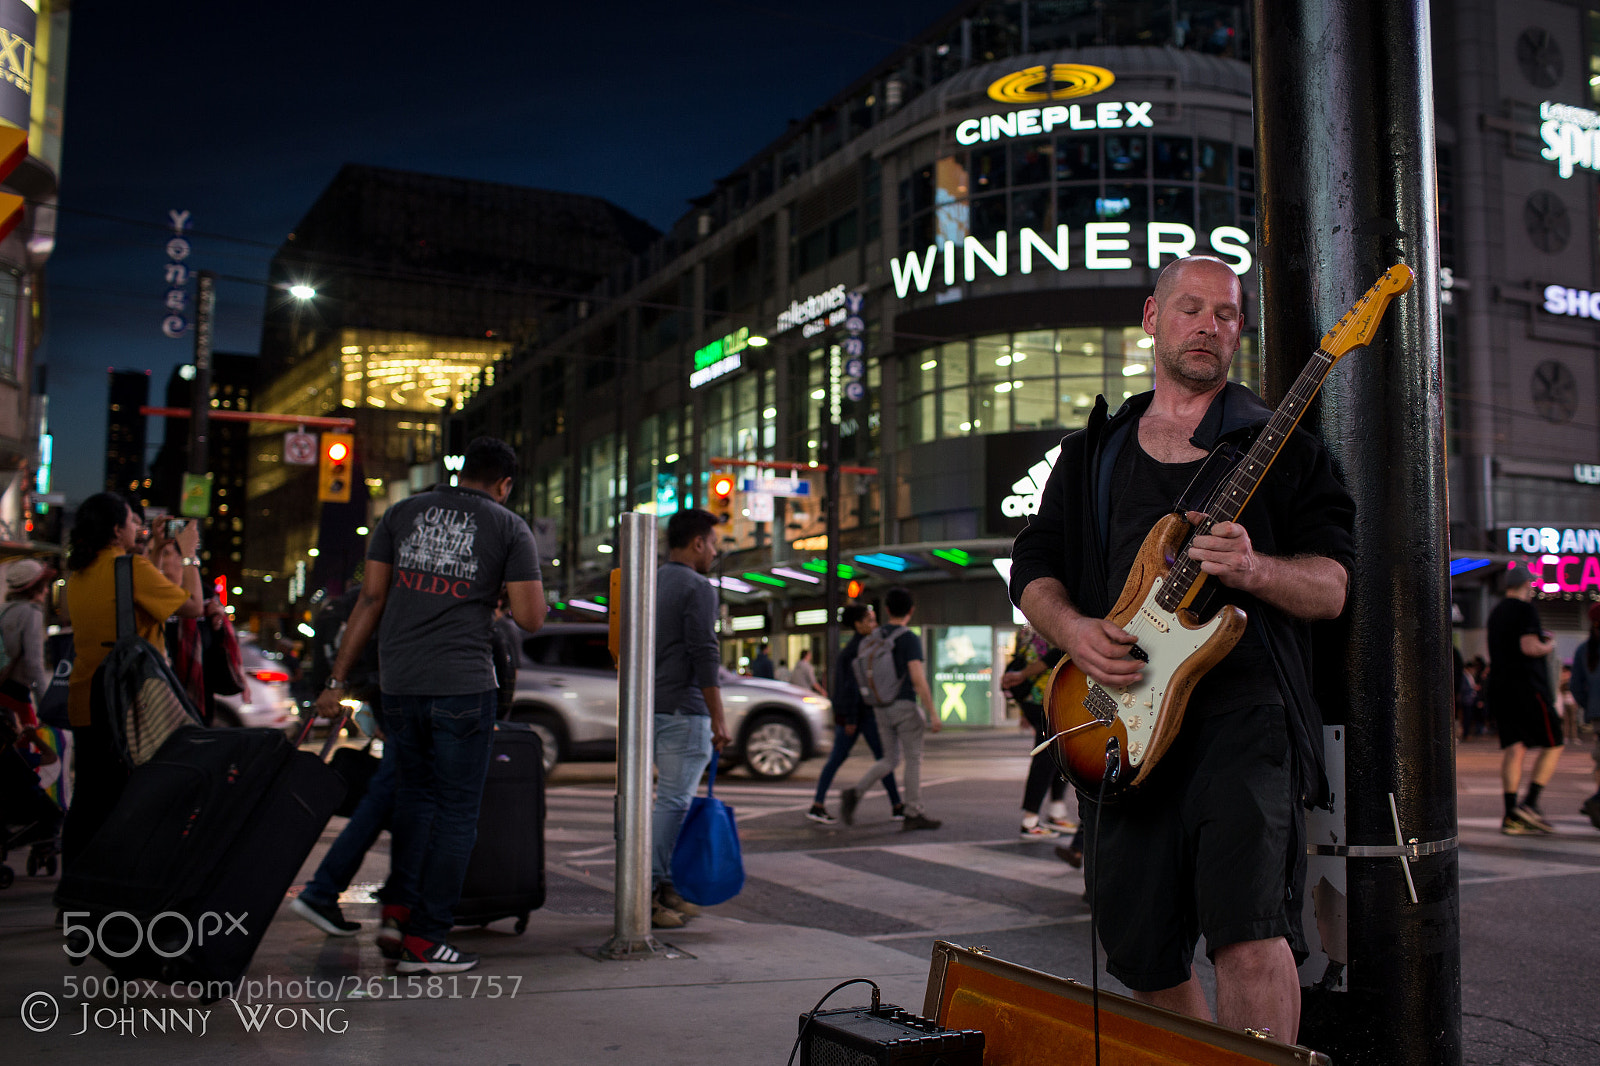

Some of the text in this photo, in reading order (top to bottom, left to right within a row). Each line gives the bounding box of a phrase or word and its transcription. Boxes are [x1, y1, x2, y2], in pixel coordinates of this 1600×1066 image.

[956, 101, 1154, 145] CINEPLEX
[890, 221, 1252, 299] WINNERS
[425, 506, 474, 529] ONLY
[1508, 527, 1560, 554] FOR
[396, 570, 470, 599] NLDC
